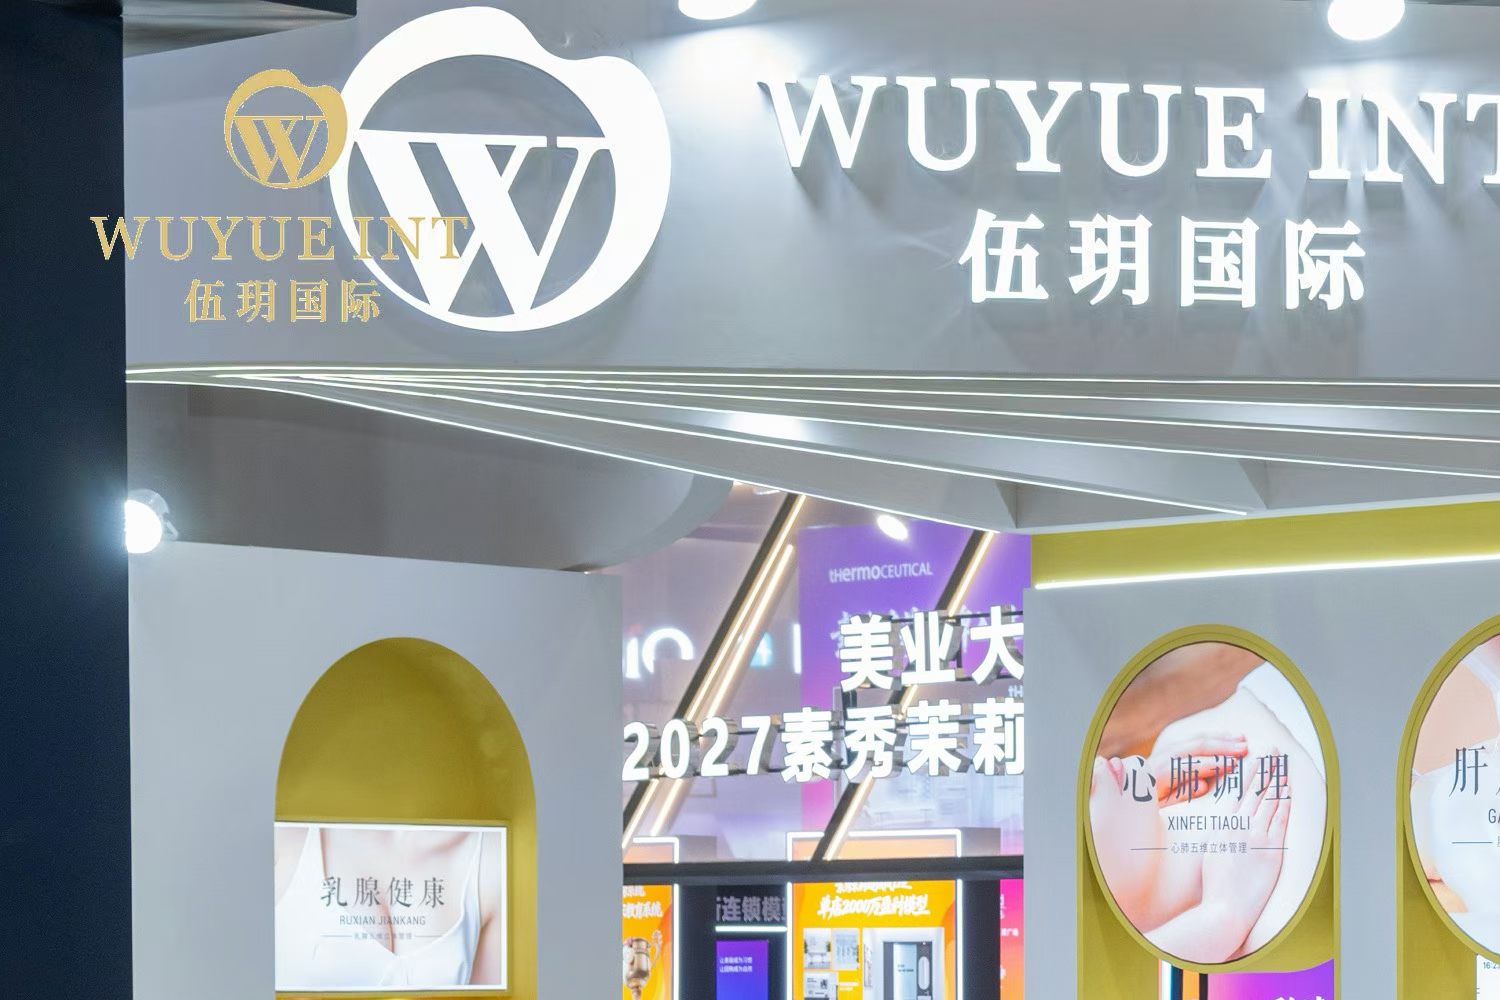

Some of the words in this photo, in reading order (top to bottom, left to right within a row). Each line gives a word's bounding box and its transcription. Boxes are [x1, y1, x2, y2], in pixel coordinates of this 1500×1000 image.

[757, 75, 1273, 181] WUYUE
[959, 208, 1367, 312] 伍玥国际
[839, 605, 1024, 693] 美业大
[622, 698, 1024, 783] 2027素秀茉莉
[1123, 754, 1292, 803] 心肺调理
[1167, 815, 1207, 831] XINFEI
[1210, 815, 1251, 831] TIAOLI
[1171, 841, 1248, 854] 心肺五维立体管理
[320, 875, 447, 909] 乳腺健康
[716, 896, 787, 922] 连锁模
[339, 915, 376, 926] RUXIAN
[378, 915, 426, 926] JIANKANG
